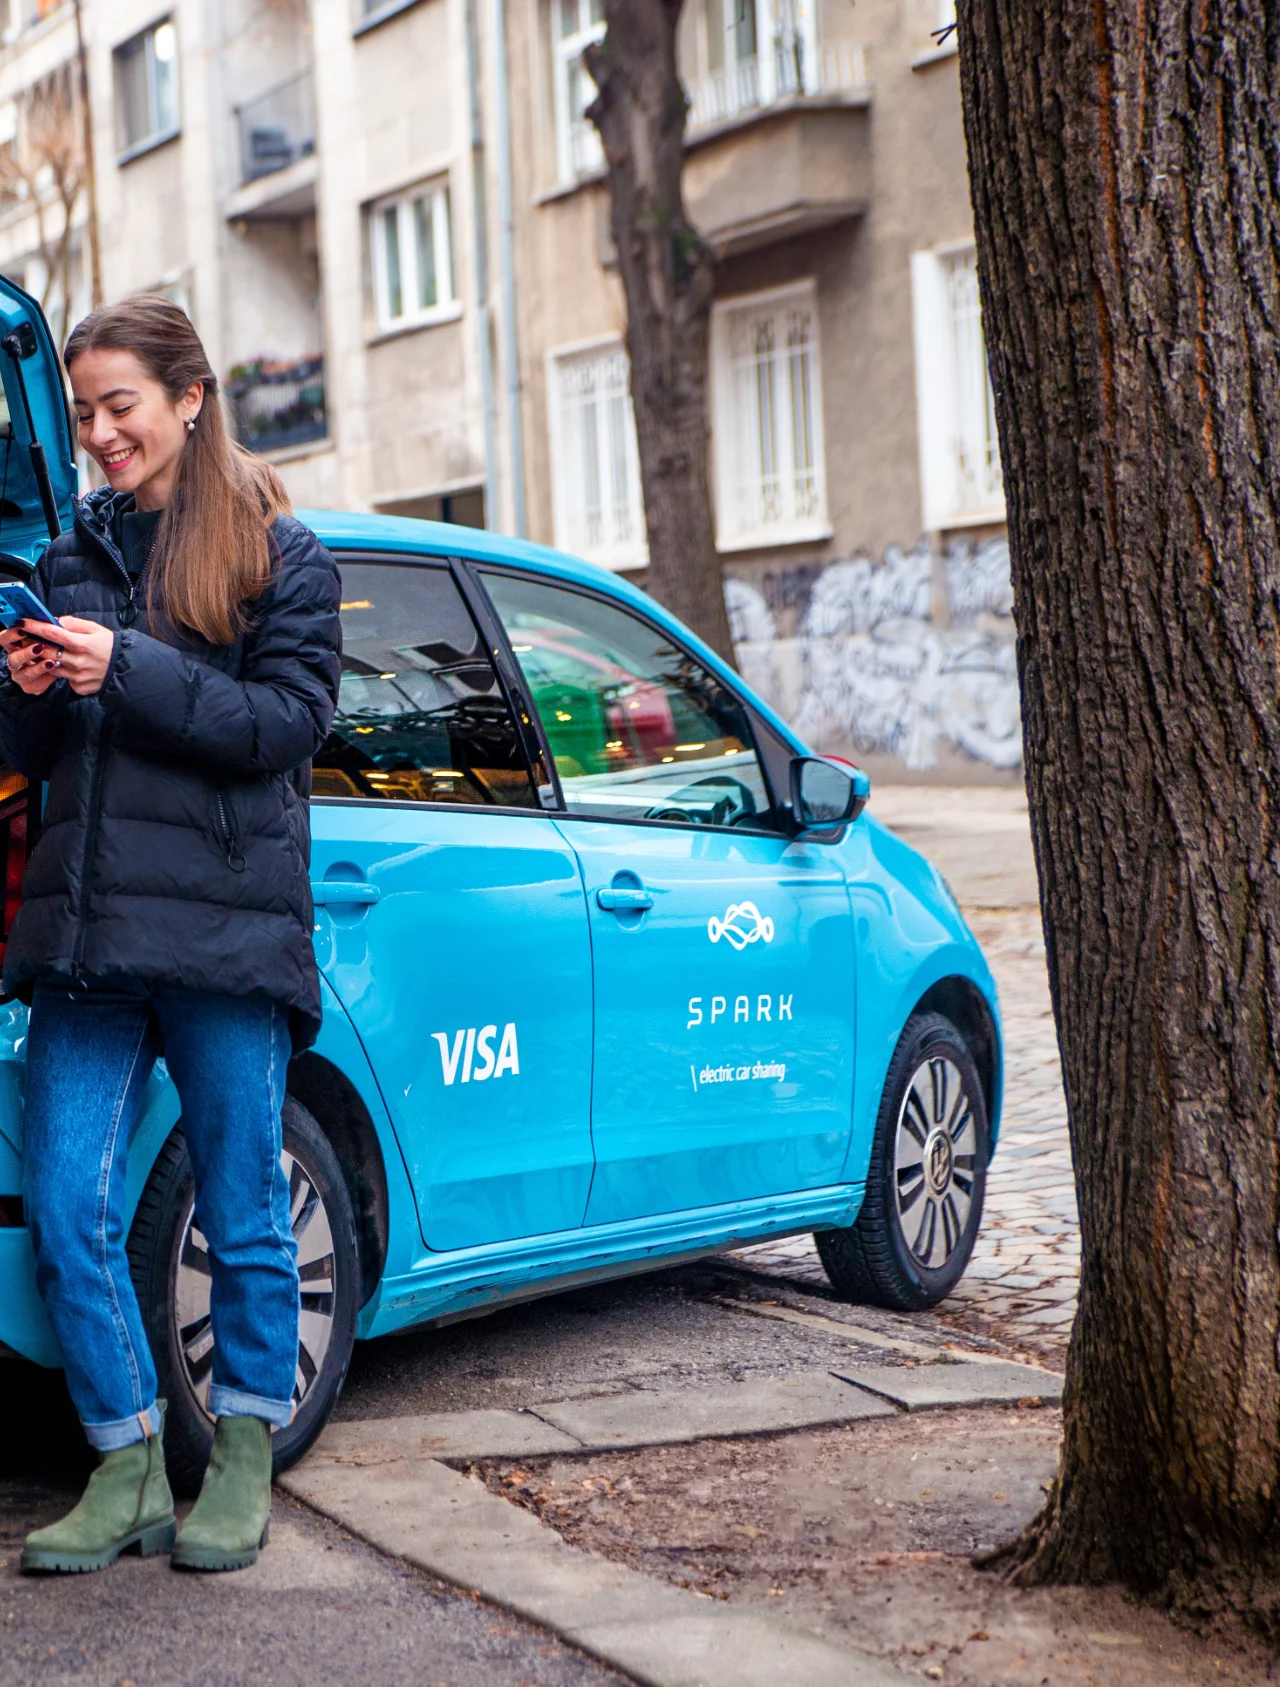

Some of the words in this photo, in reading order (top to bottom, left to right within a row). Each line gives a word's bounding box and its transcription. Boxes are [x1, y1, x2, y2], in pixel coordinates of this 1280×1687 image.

[687, 994, 793, 1029] SPARK
[431, 1022, 520, 1086] VISA
[699, 1063, 734, 1084] electric
[735, 1065, 751, 1081] car
[752, 1059, 786, 1083] sharing
